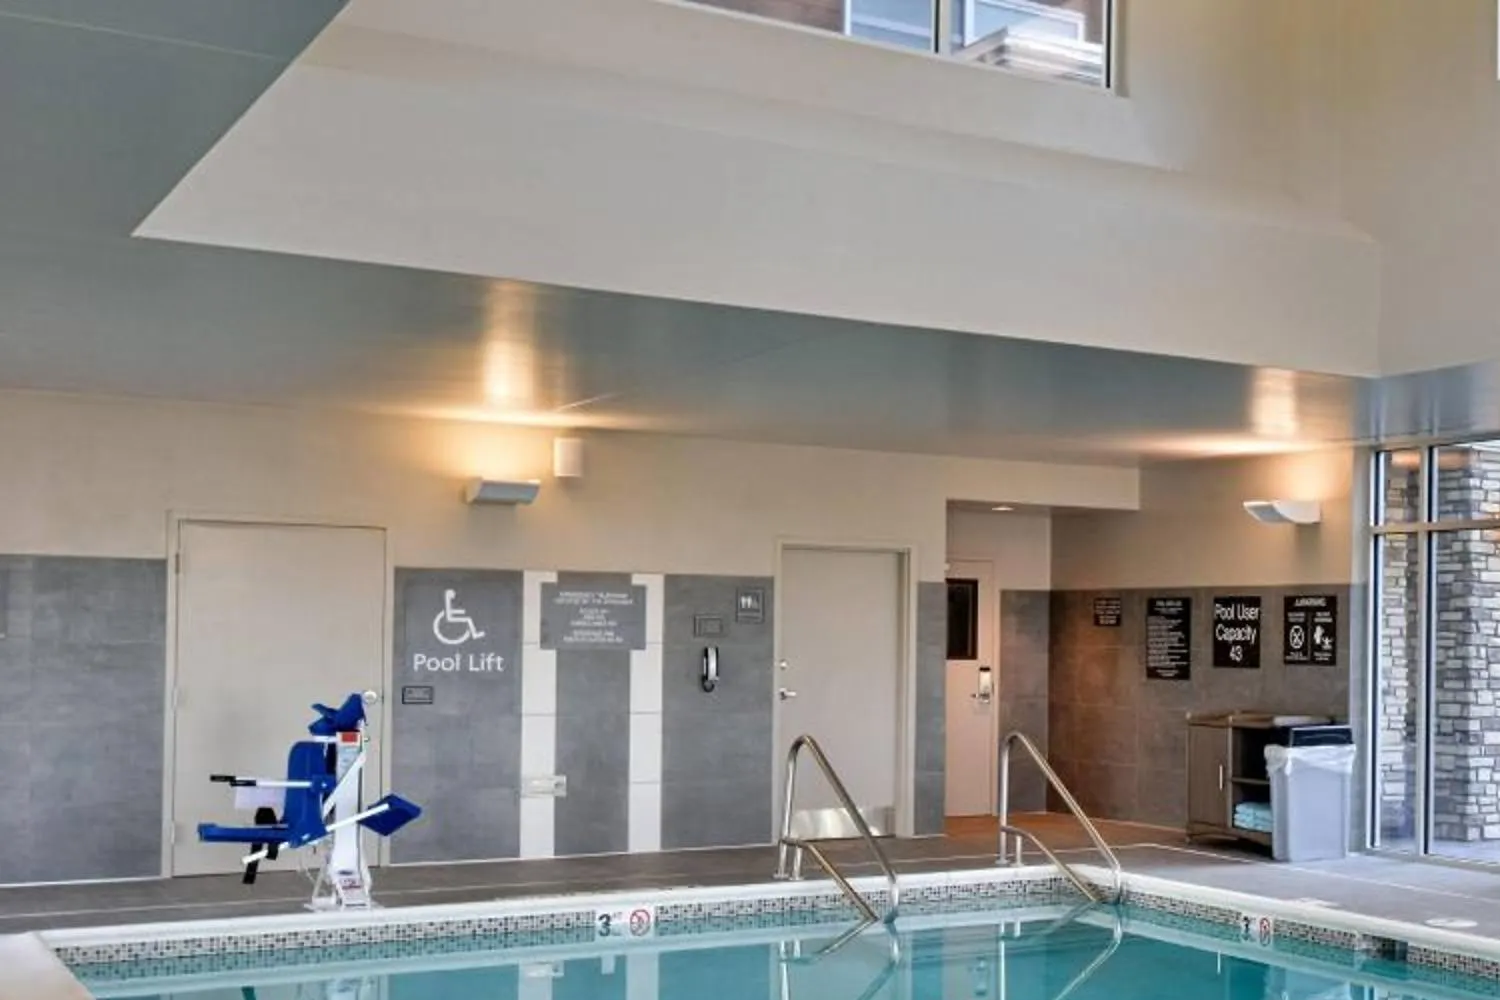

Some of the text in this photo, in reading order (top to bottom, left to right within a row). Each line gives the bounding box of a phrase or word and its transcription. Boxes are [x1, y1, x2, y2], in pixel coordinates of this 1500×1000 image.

[1215, 603, 1260, 620] Pool User
[1216, 623, 1257, 645] Capacity
[413, 652, 504, 671] Pool Lift
[1229, 645, 1243, 662] 43
